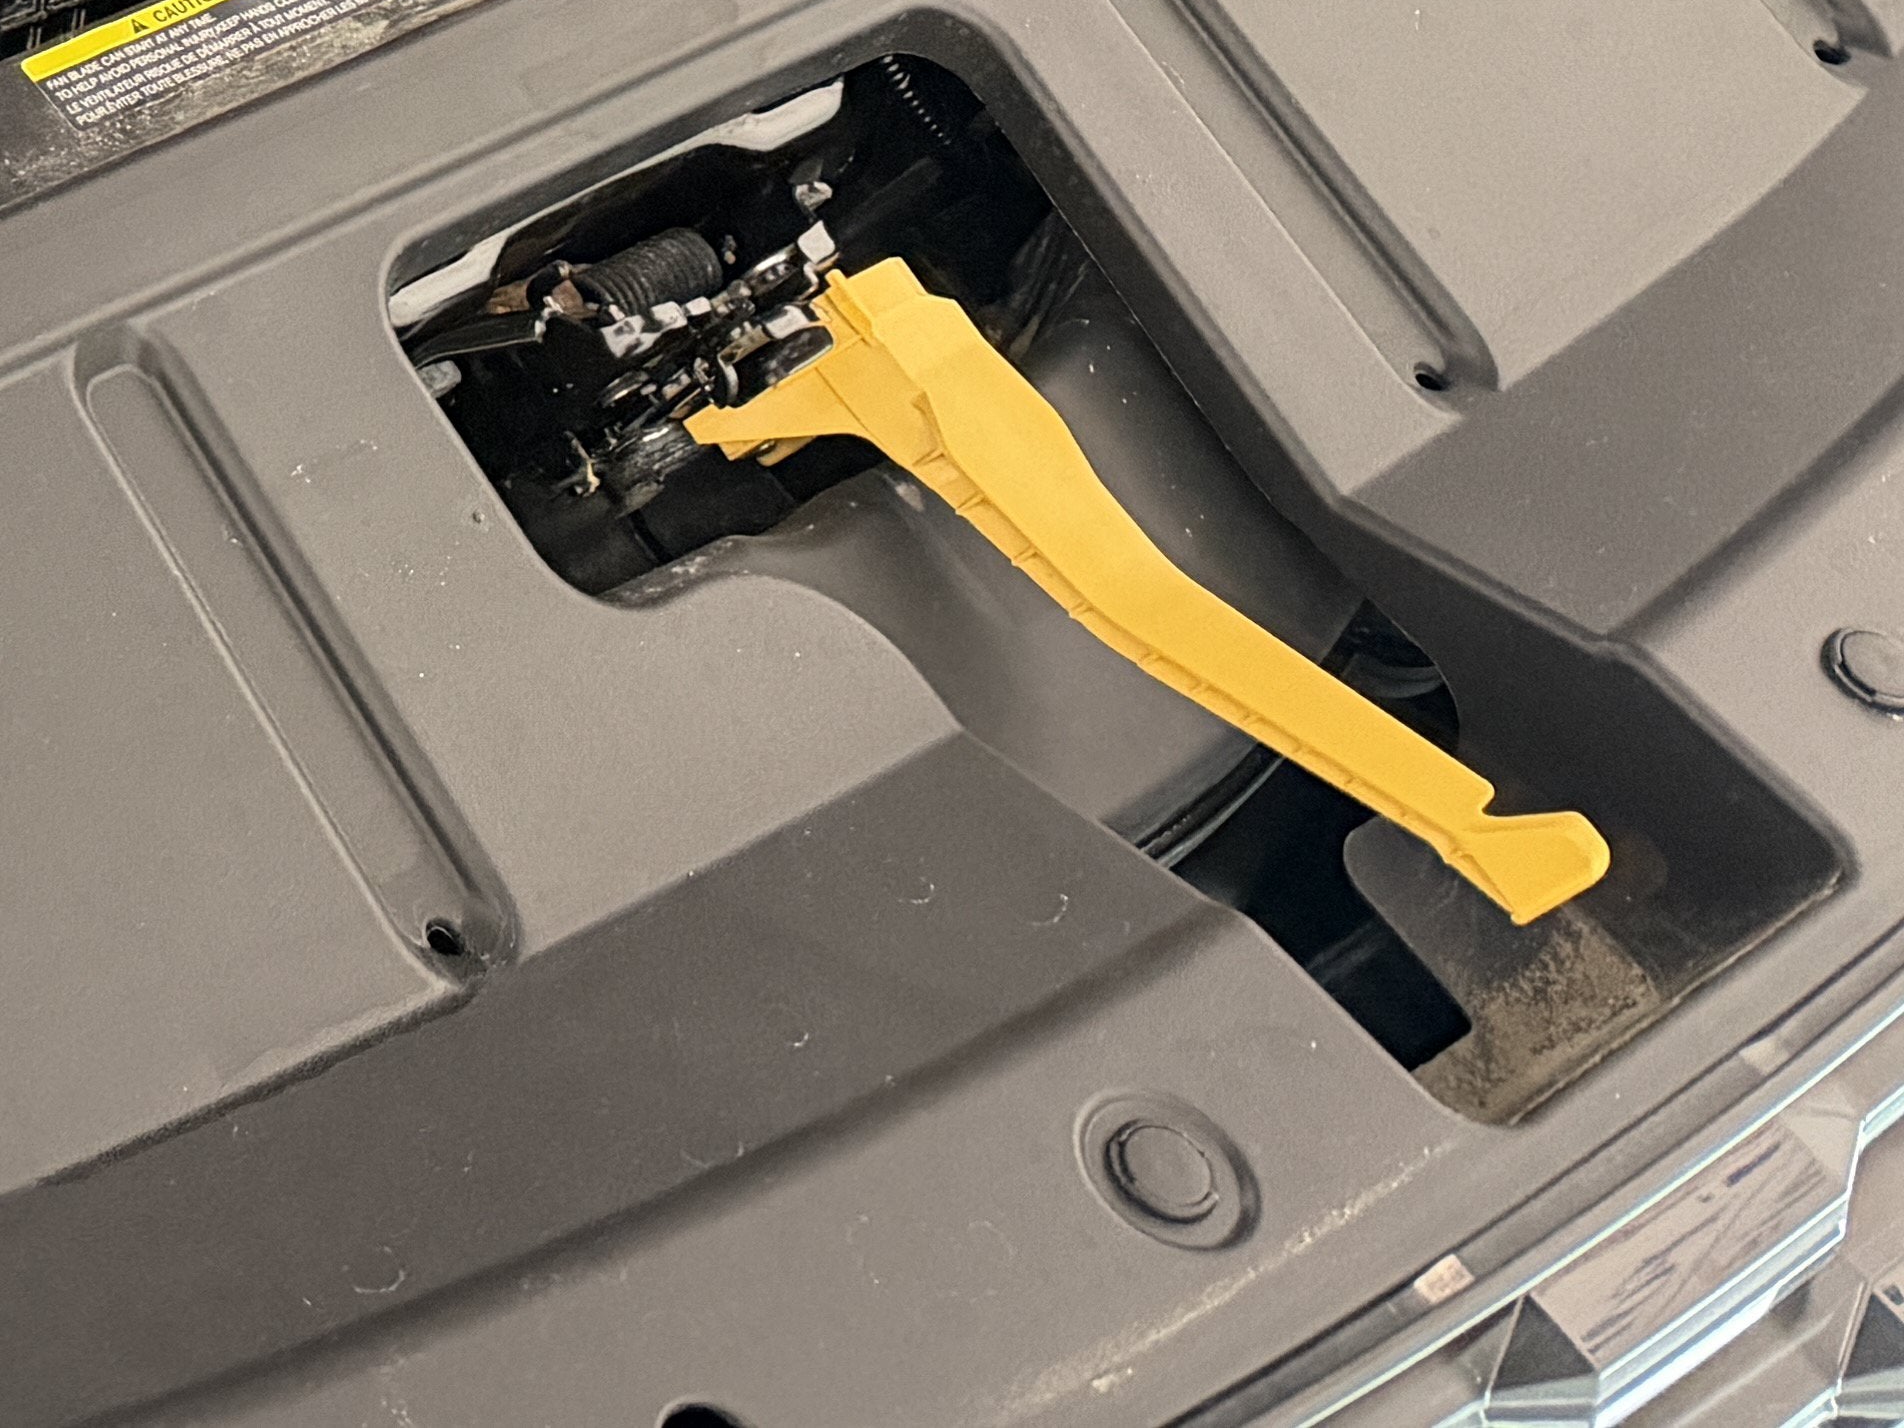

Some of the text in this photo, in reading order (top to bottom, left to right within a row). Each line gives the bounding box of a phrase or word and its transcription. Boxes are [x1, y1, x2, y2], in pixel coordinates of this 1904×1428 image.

[46, 75, 67, 90] FAN
[67, 60, 102, 81] BLADE
[101, 50, 125, 66] CAN
[124, 38, 154, 56] START
[168, 23, 189, 38] ANY
[55, 88, 73, 101] TO
[71, 77, 99, 95] HELP
[98, 63, 132, 83] AVOID
[130, 40, 183, 69] PERSONAL
[241, 1, 275, 22] HANDS
[66, 102, 82, 114] LE
[80, 74, 145, 108] VENTILATEUR
[144, 58, 182, 80] RISQUE
[180, 51, 198, 64] DE
[140, 77, 173, 97] TOUTE
[226, 47, 243, 60] NE
[241, 37, 264, 54] PAS
[262, 32, 279, 44] EN
